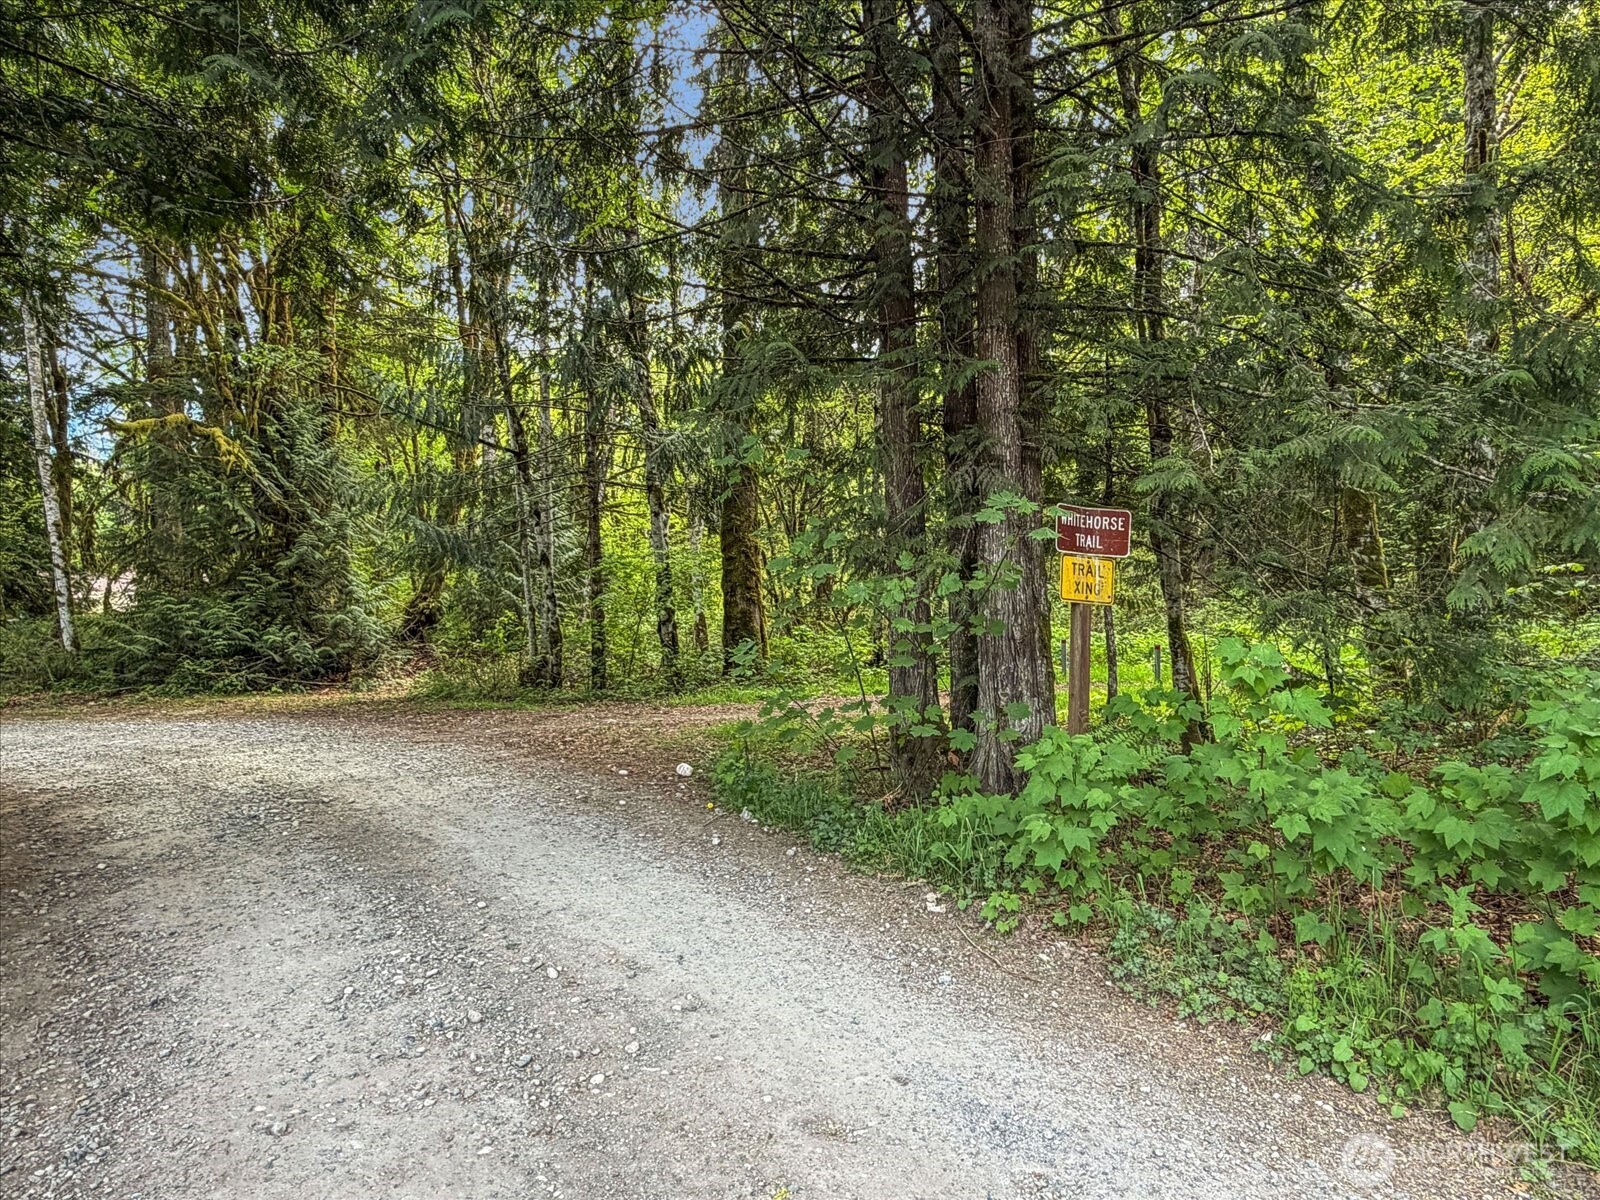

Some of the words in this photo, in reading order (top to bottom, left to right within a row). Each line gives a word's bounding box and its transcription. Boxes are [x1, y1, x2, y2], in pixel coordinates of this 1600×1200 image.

[1061, 514, 1125, 531] WHITEHORSE
[1075, 533, 1103, 549] TRAIL
[1071, 562, 1104, 578] TRAIL
[1074, 581, 1101, 596] XING
